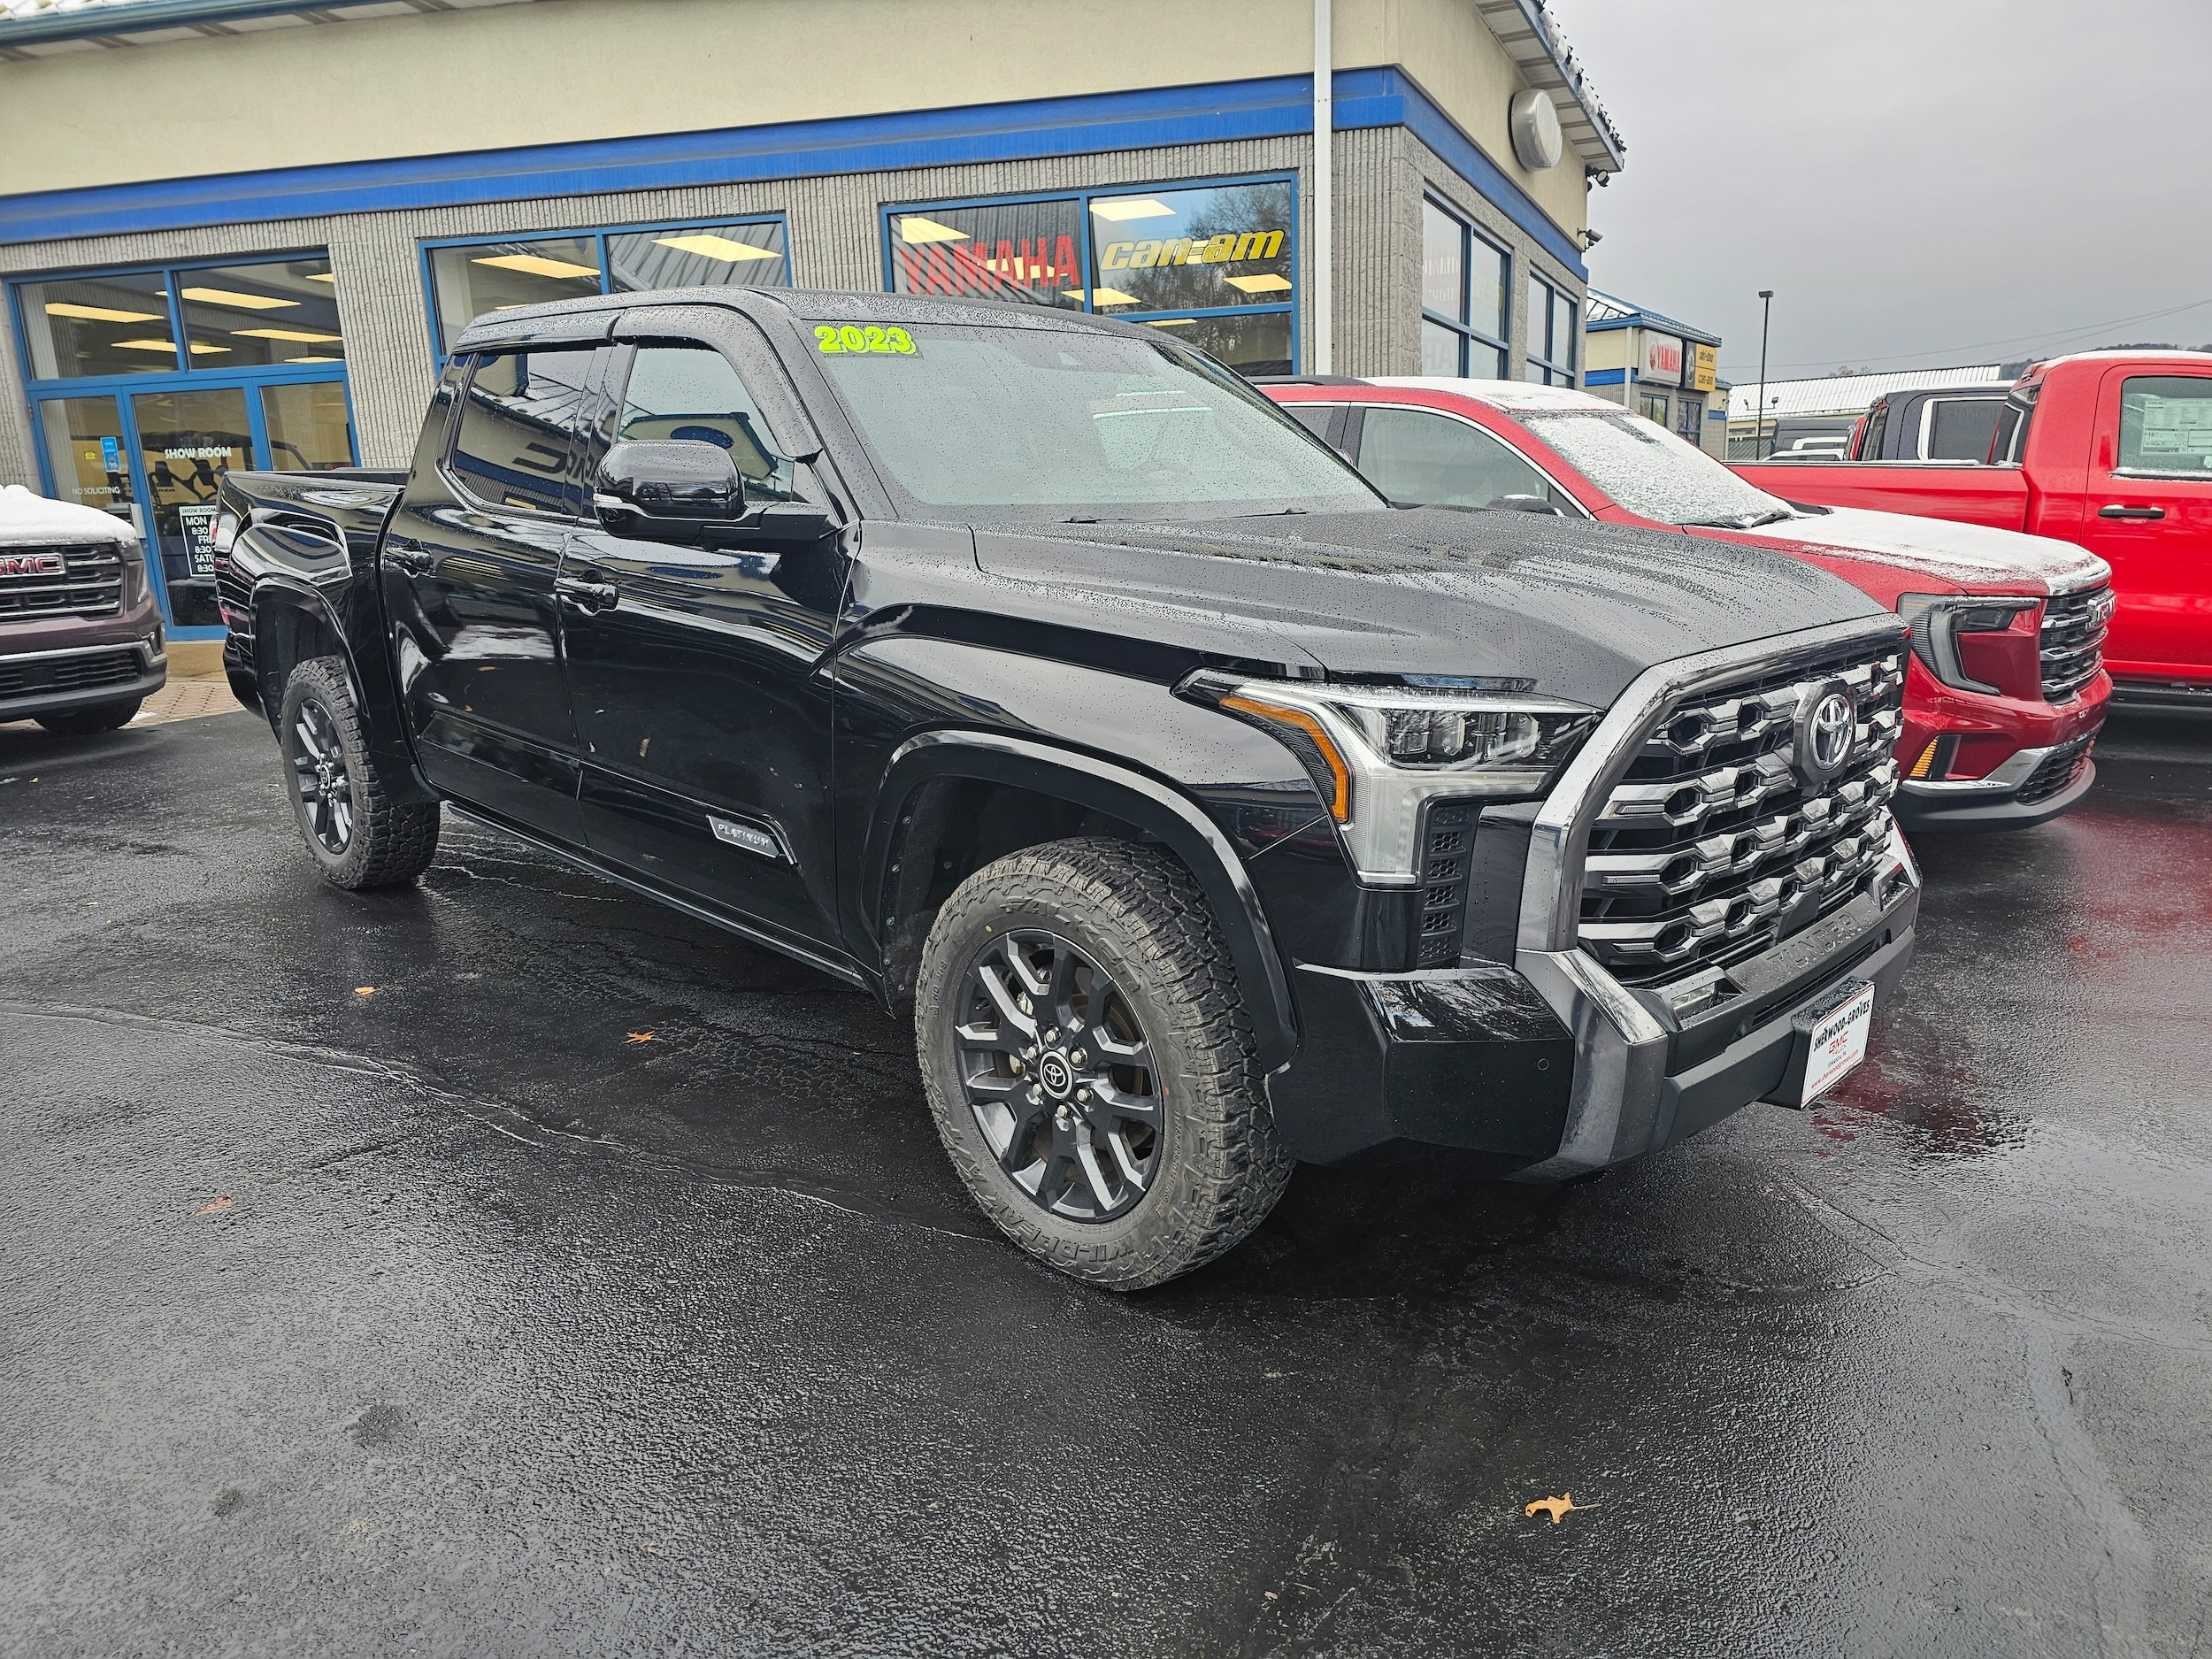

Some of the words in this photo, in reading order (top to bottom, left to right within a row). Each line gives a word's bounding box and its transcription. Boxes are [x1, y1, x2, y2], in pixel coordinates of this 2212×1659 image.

[1100, 229, 1286, 271] can-am
[900, 234, 1080, 296] YAMAHA
[814, 326, 917, 355] 2023
[1656, 344, 1680, 373] YAMAHA
[164, 448, 196, 459] SHOW
[198, 446, 232, 458] ROOM
[84, 486, 120, 495] SOLICITING
[185, 516, 207, 526] MON
[197, 535, 210, 544] FR
[0, 556, 62, 575] MC
[195, 554, 214, 564] SATU
[718, 823, 770, 848] PLATINUM
[999, 895, 1142, 994] FALKEN
[1766, 913, 1861, 975] TUNDRA
[1813, 998, 1870, 1053] SHERWOOD-GROVES
[1828, 1031, 1849, 1054] GMC
[1810, 1048, 1860, 1089] www.sherwoodgroves.com
[986, 1188, 1136, 1263] WILDPEAK
